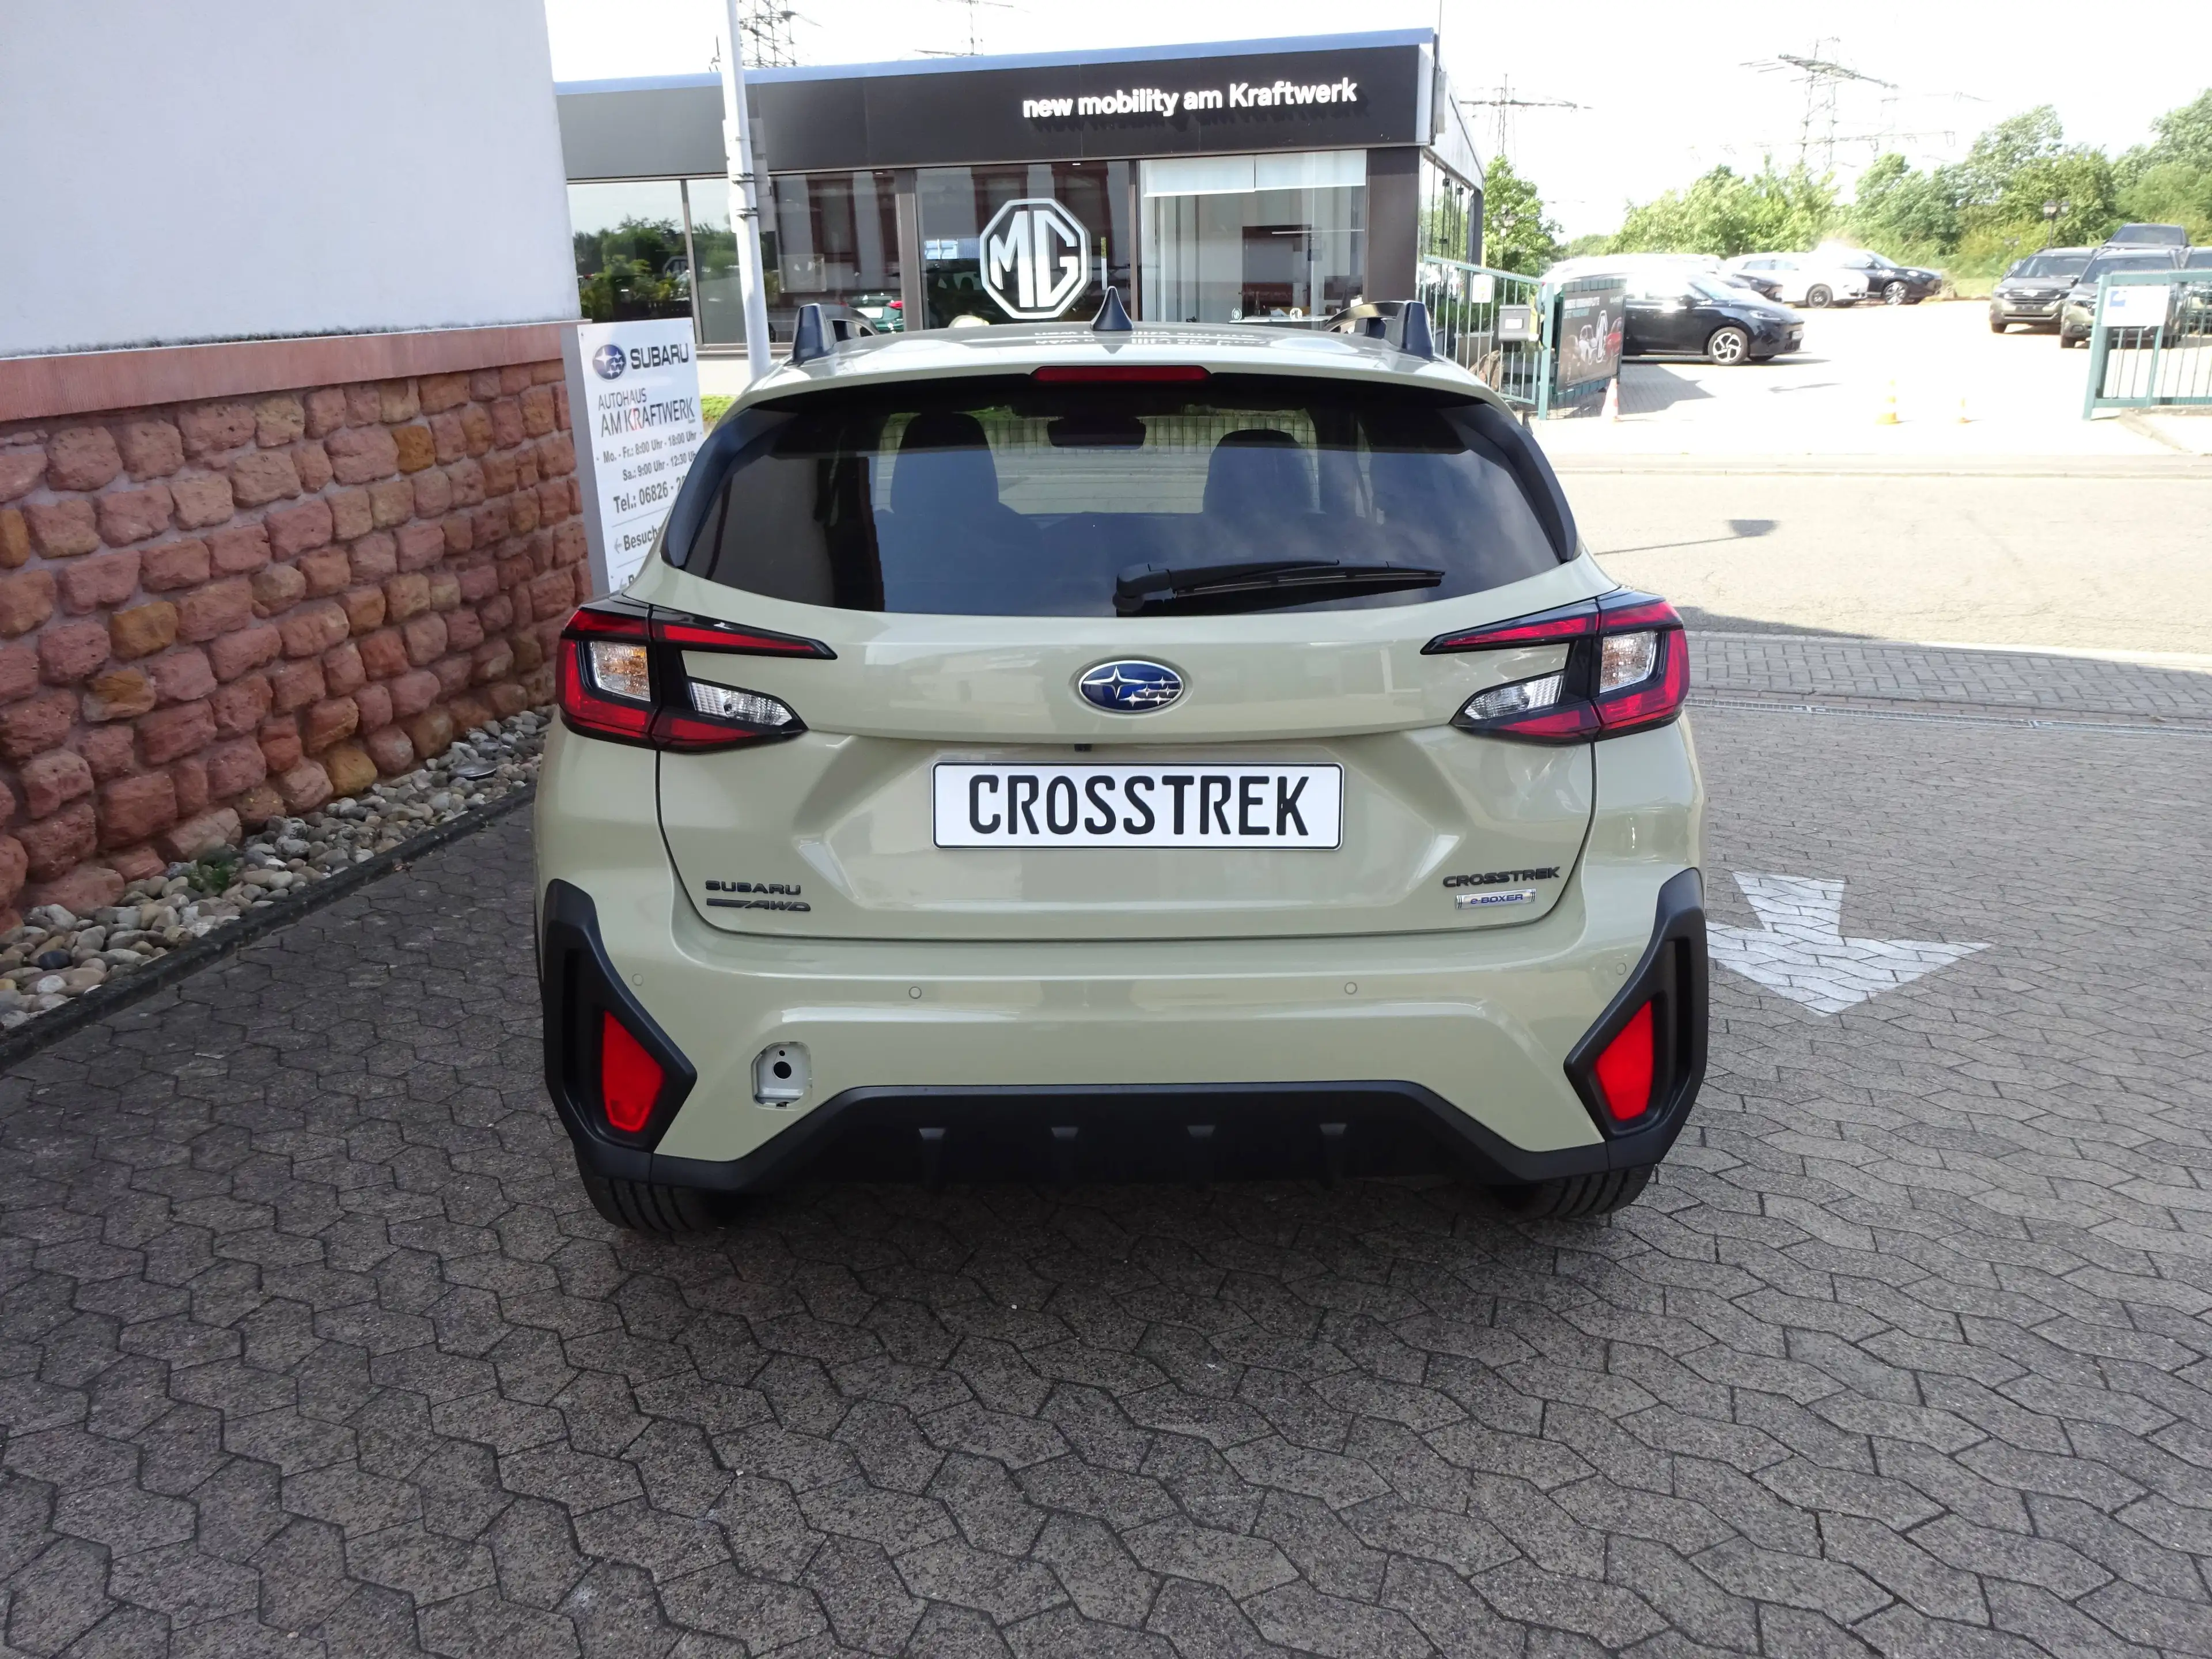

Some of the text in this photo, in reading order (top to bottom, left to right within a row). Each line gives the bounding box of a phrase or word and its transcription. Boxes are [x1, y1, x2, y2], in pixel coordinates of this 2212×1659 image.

[1023, 77, 1358, 118] new mobility am Kraftwerk
[990, 210, 1078, 307] MG
[630, 343, 689, 369] SUBARU
[599, 388, 647, 411] AUTOHAUS
[601, 397, 695, 437] AM KRAFTWERK
[603, 450, 616, 463] Mo.
[623, 446, 634, 459] Fr.:
[635, 441, 650, 455] 8:00
[651, 439, 662, 450] Uhr
[668, 433, 684, 446] 18:00
[687, 430, 696, 442] Uhr
[623, 469, 637, 481] Sa.:
[637, 463, 652, 476] 9:00
[653, 460, 665, 472] Uhr
[671, 453, 687, 467] 12:30
[613, 493, 637, 514] Tel.:
[639, 481, 668, 506] 06826
[968, 774, 1309, 836] CROSSTREK
[705, 880, 801, 895] SUBARU
[1443, 866, 1560, 888] CROSSTREK
[745, 900, 811, 911] AWD
[1471, 893, 1524, 904] e-BOXER
